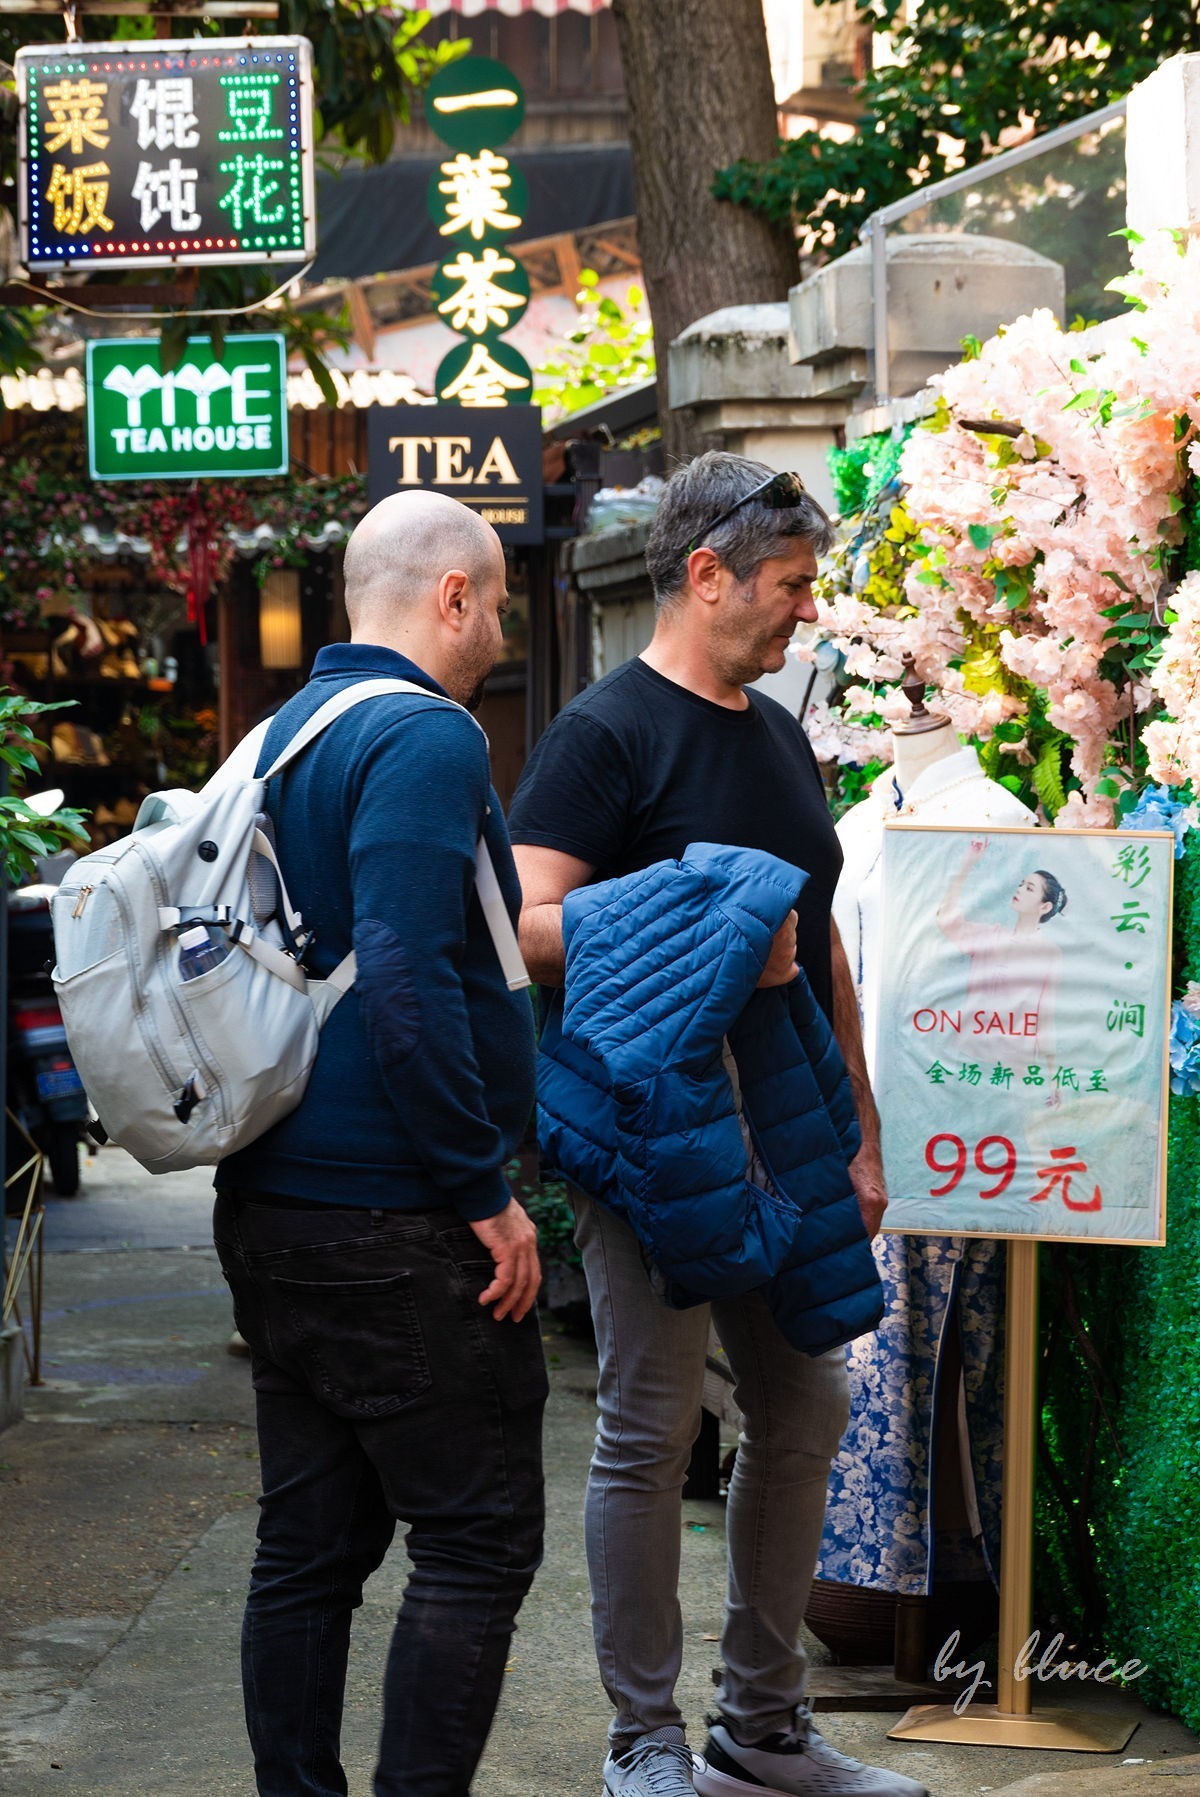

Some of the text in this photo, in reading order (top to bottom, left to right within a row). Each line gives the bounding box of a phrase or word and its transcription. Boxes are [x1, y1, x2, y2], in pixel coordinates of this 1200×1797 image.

[43, 78, 115, 235] 菜饭
[129, 77, 202, 232] 馄饨
[218, 74, 285, 231] 豆花
[110, 425, 272, 453] TEA HOUSE
[388, 435, 522, 485] TEA
[912, 1008, 1039, 1036] ON SALE
[924, 1059, 1110, 1093] 全场新品低至
